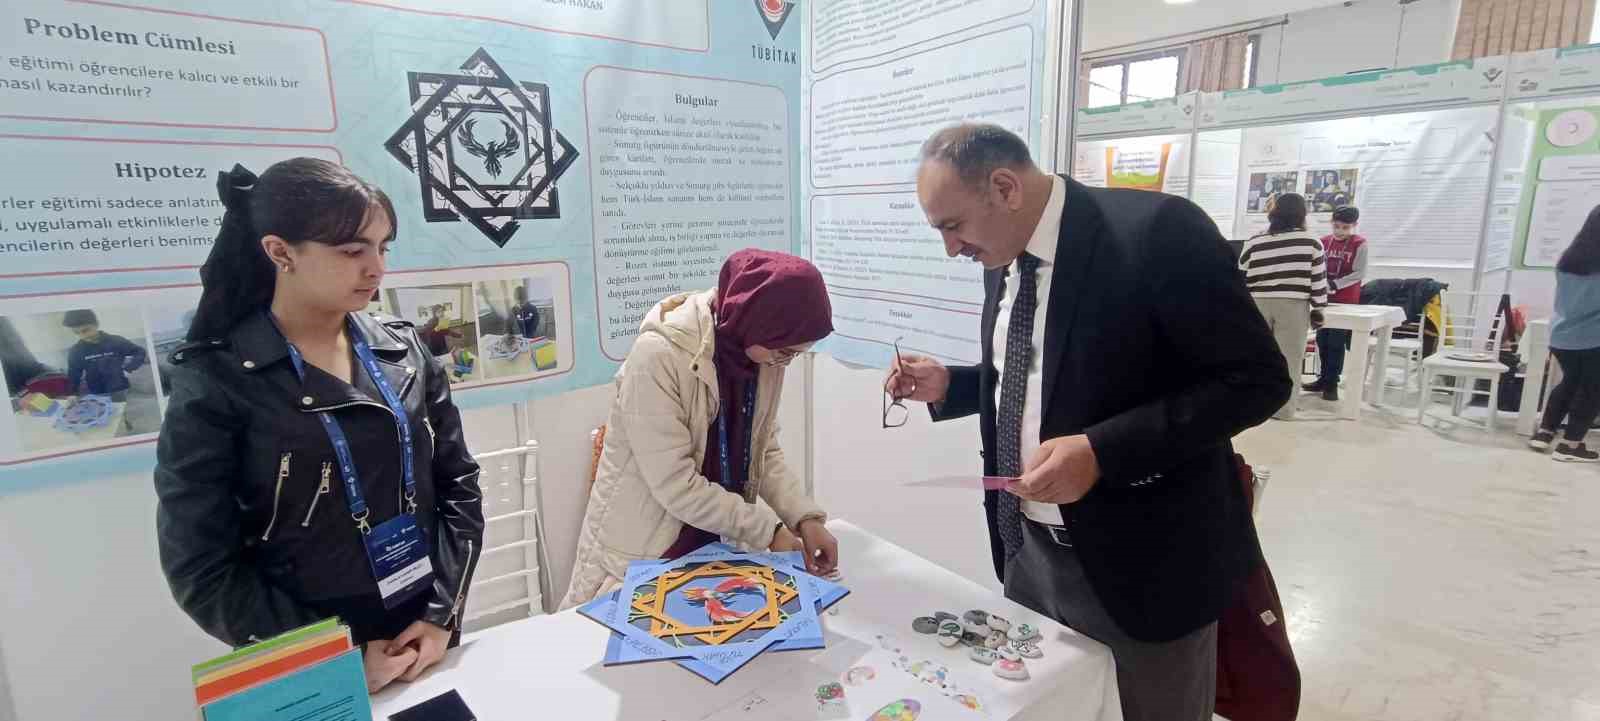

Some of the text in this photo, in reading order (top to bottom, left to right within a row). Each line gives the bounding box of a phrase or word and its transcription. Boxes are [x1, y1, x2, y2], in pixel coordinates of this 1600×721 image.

[24, 17, 237, 55] Problem Cümlesi
[751, 43, 798, 65] TÜBİTAK
[9, 55, 300, 89] eğitimi öğrencilere kalıcı ve etkili bir
[47, 80, 152, 98] kazandırılır?
[674, 94, 720, 108] Bulgular
[114, 162, 208, 182] Hipotez
[41, 196, 102, 213] eğitimi
[106, 196, 163, 209] sadece
[15, 217, 113, 234] uygulamalı
[117, 215, 209, 230] etkinliklerle
[79, 235, 154, 252] değerleri
